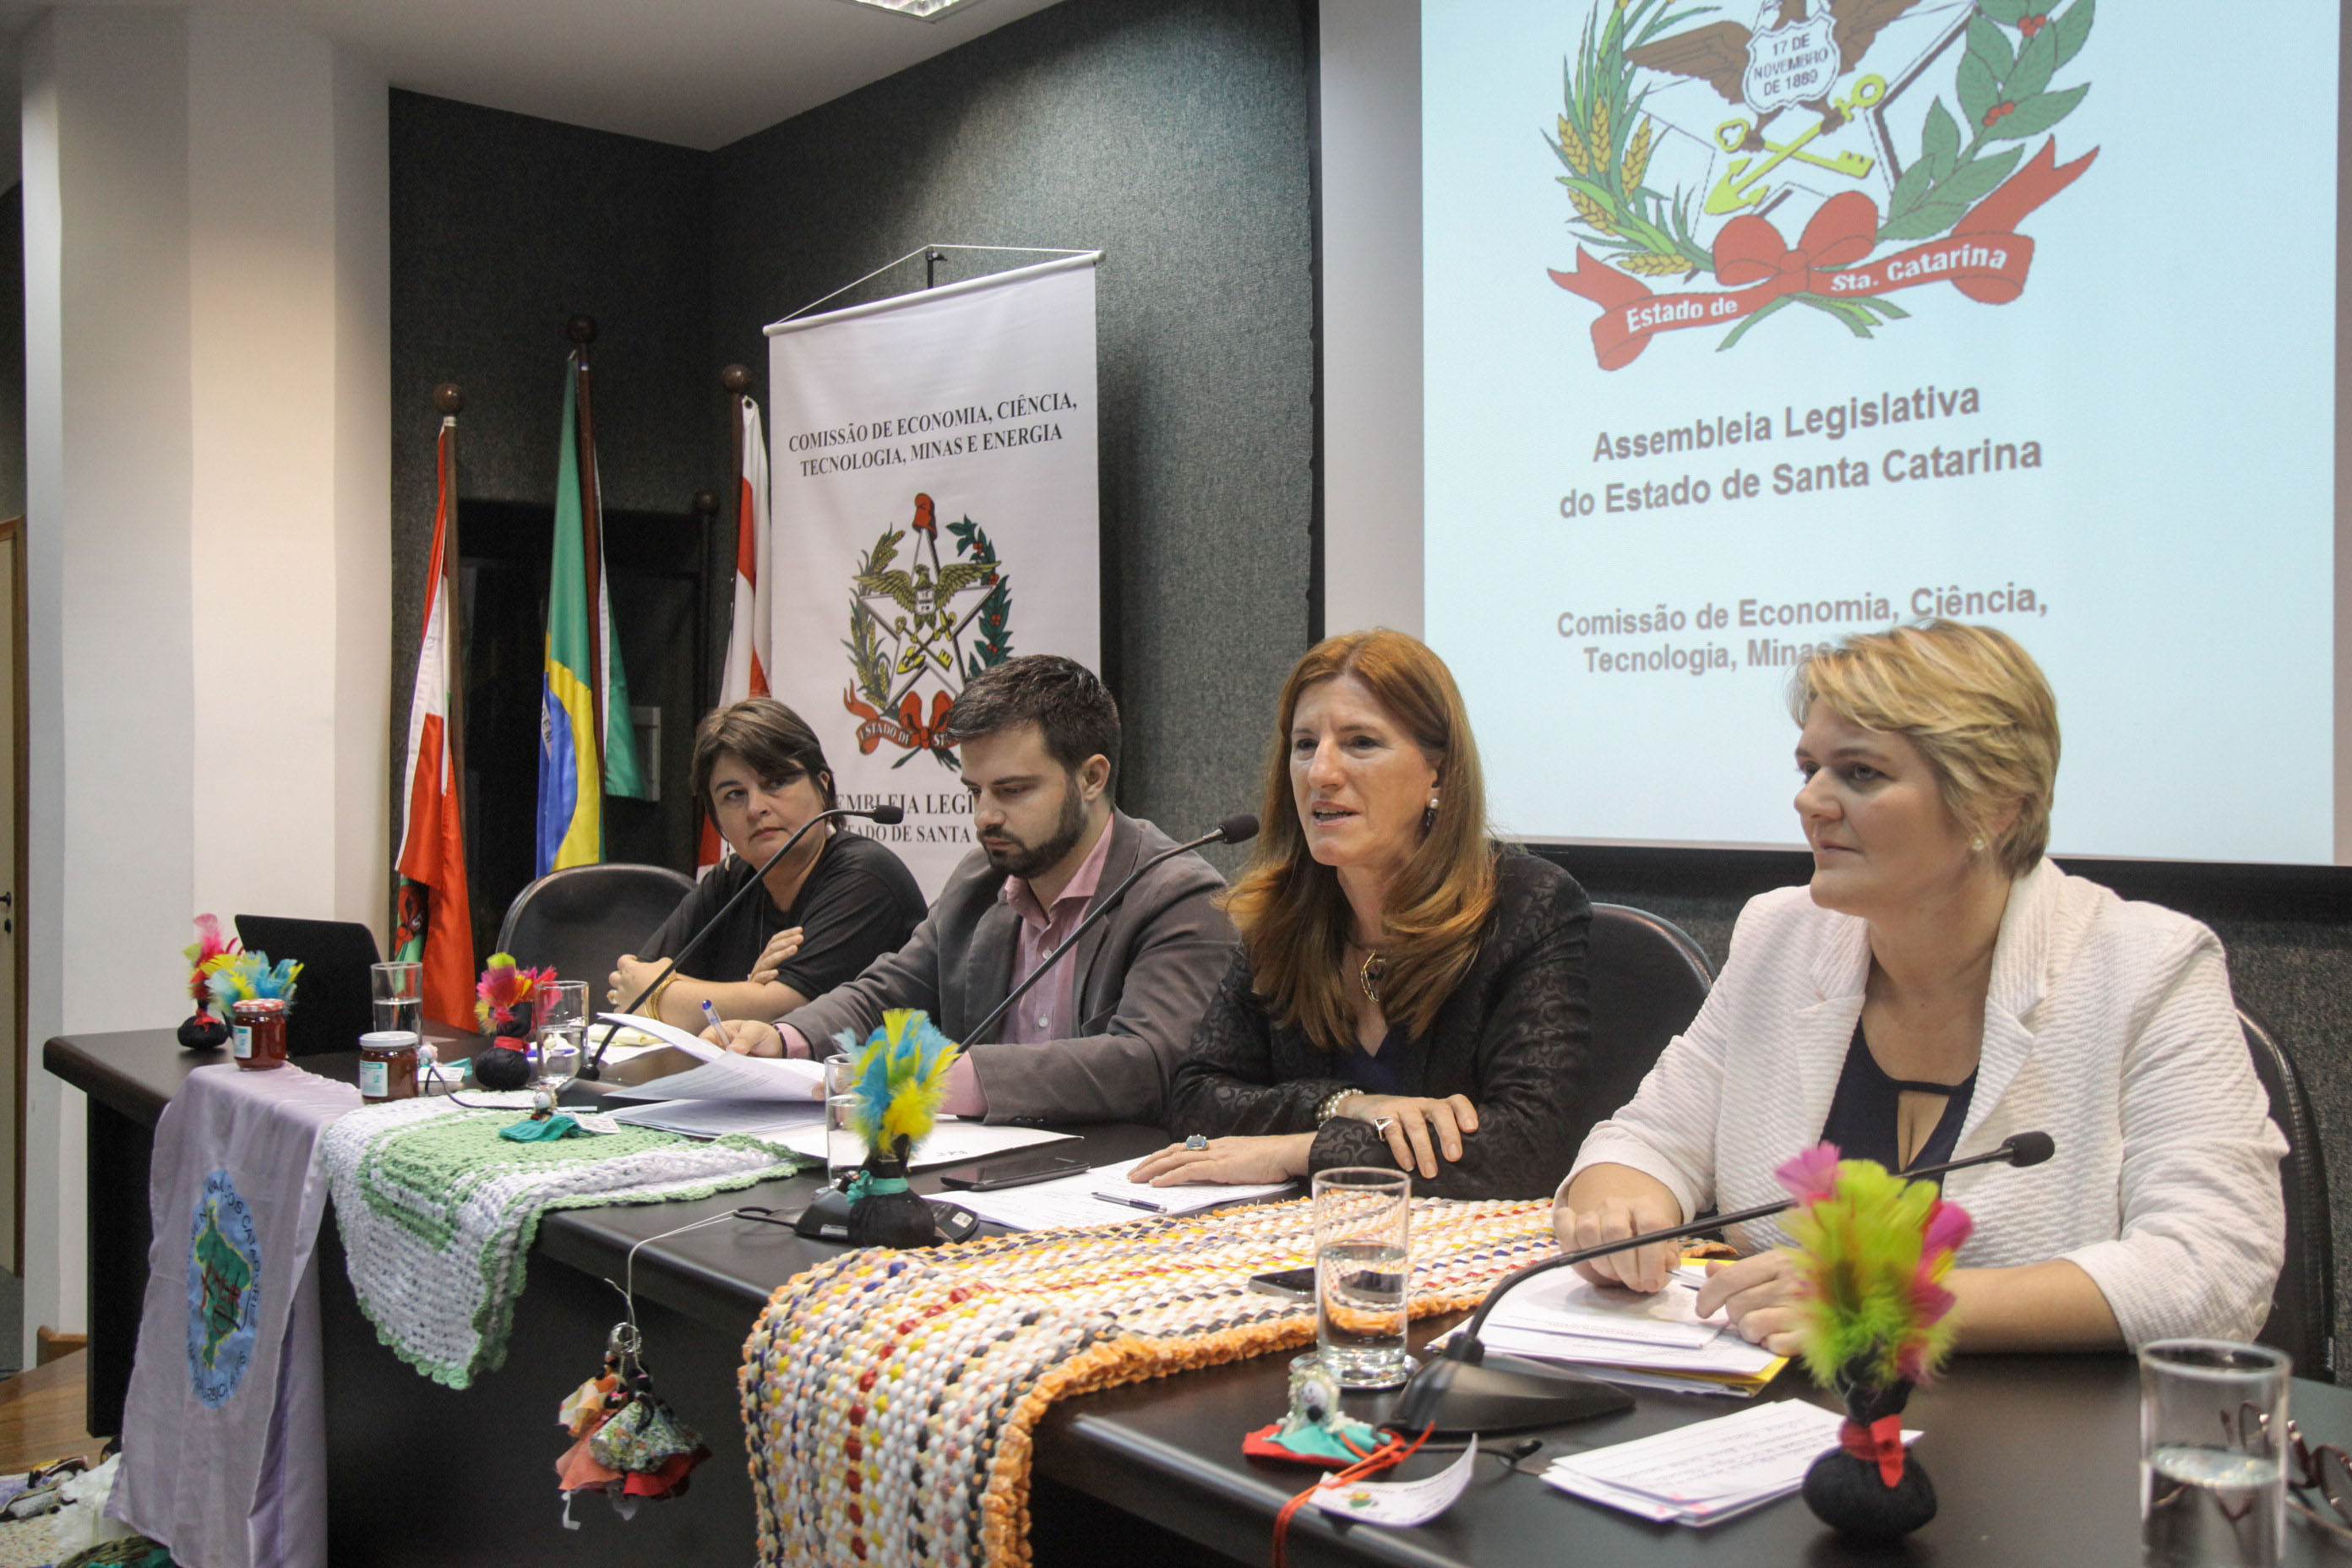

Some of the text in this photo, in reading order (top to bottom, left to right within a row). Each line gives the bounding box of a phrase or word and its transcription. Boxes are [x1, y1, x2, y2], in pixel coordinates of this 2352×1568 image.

[1754, 47, 1828, 79] NOVEMBRO
[1773, 33, 1810, 56] 17 DE
[1764, 79, 1780, 96] DE
[1626, 242, 2008, 334] Estado de Sta. Catarina
[789, 391, 1077, 452] COMISSÃO DE ECONOMIA, CIÊNCIA,
[1593, 385, 1980, 462] Assembleia Legislativa
[800, 423, 1062, 477] TECNOLOGIA, MINAS E ENERGIA
[1560, 438, 2042, 518] do Estado de Santa Catarina
[1558, 582, 2048, 637] Comissão de Economia, Ciência,
[1583, 641, 1738, 675] Tecnologia,
[891, 825, 912, 841] DE
[917, 825, 971, 843] SANTA
